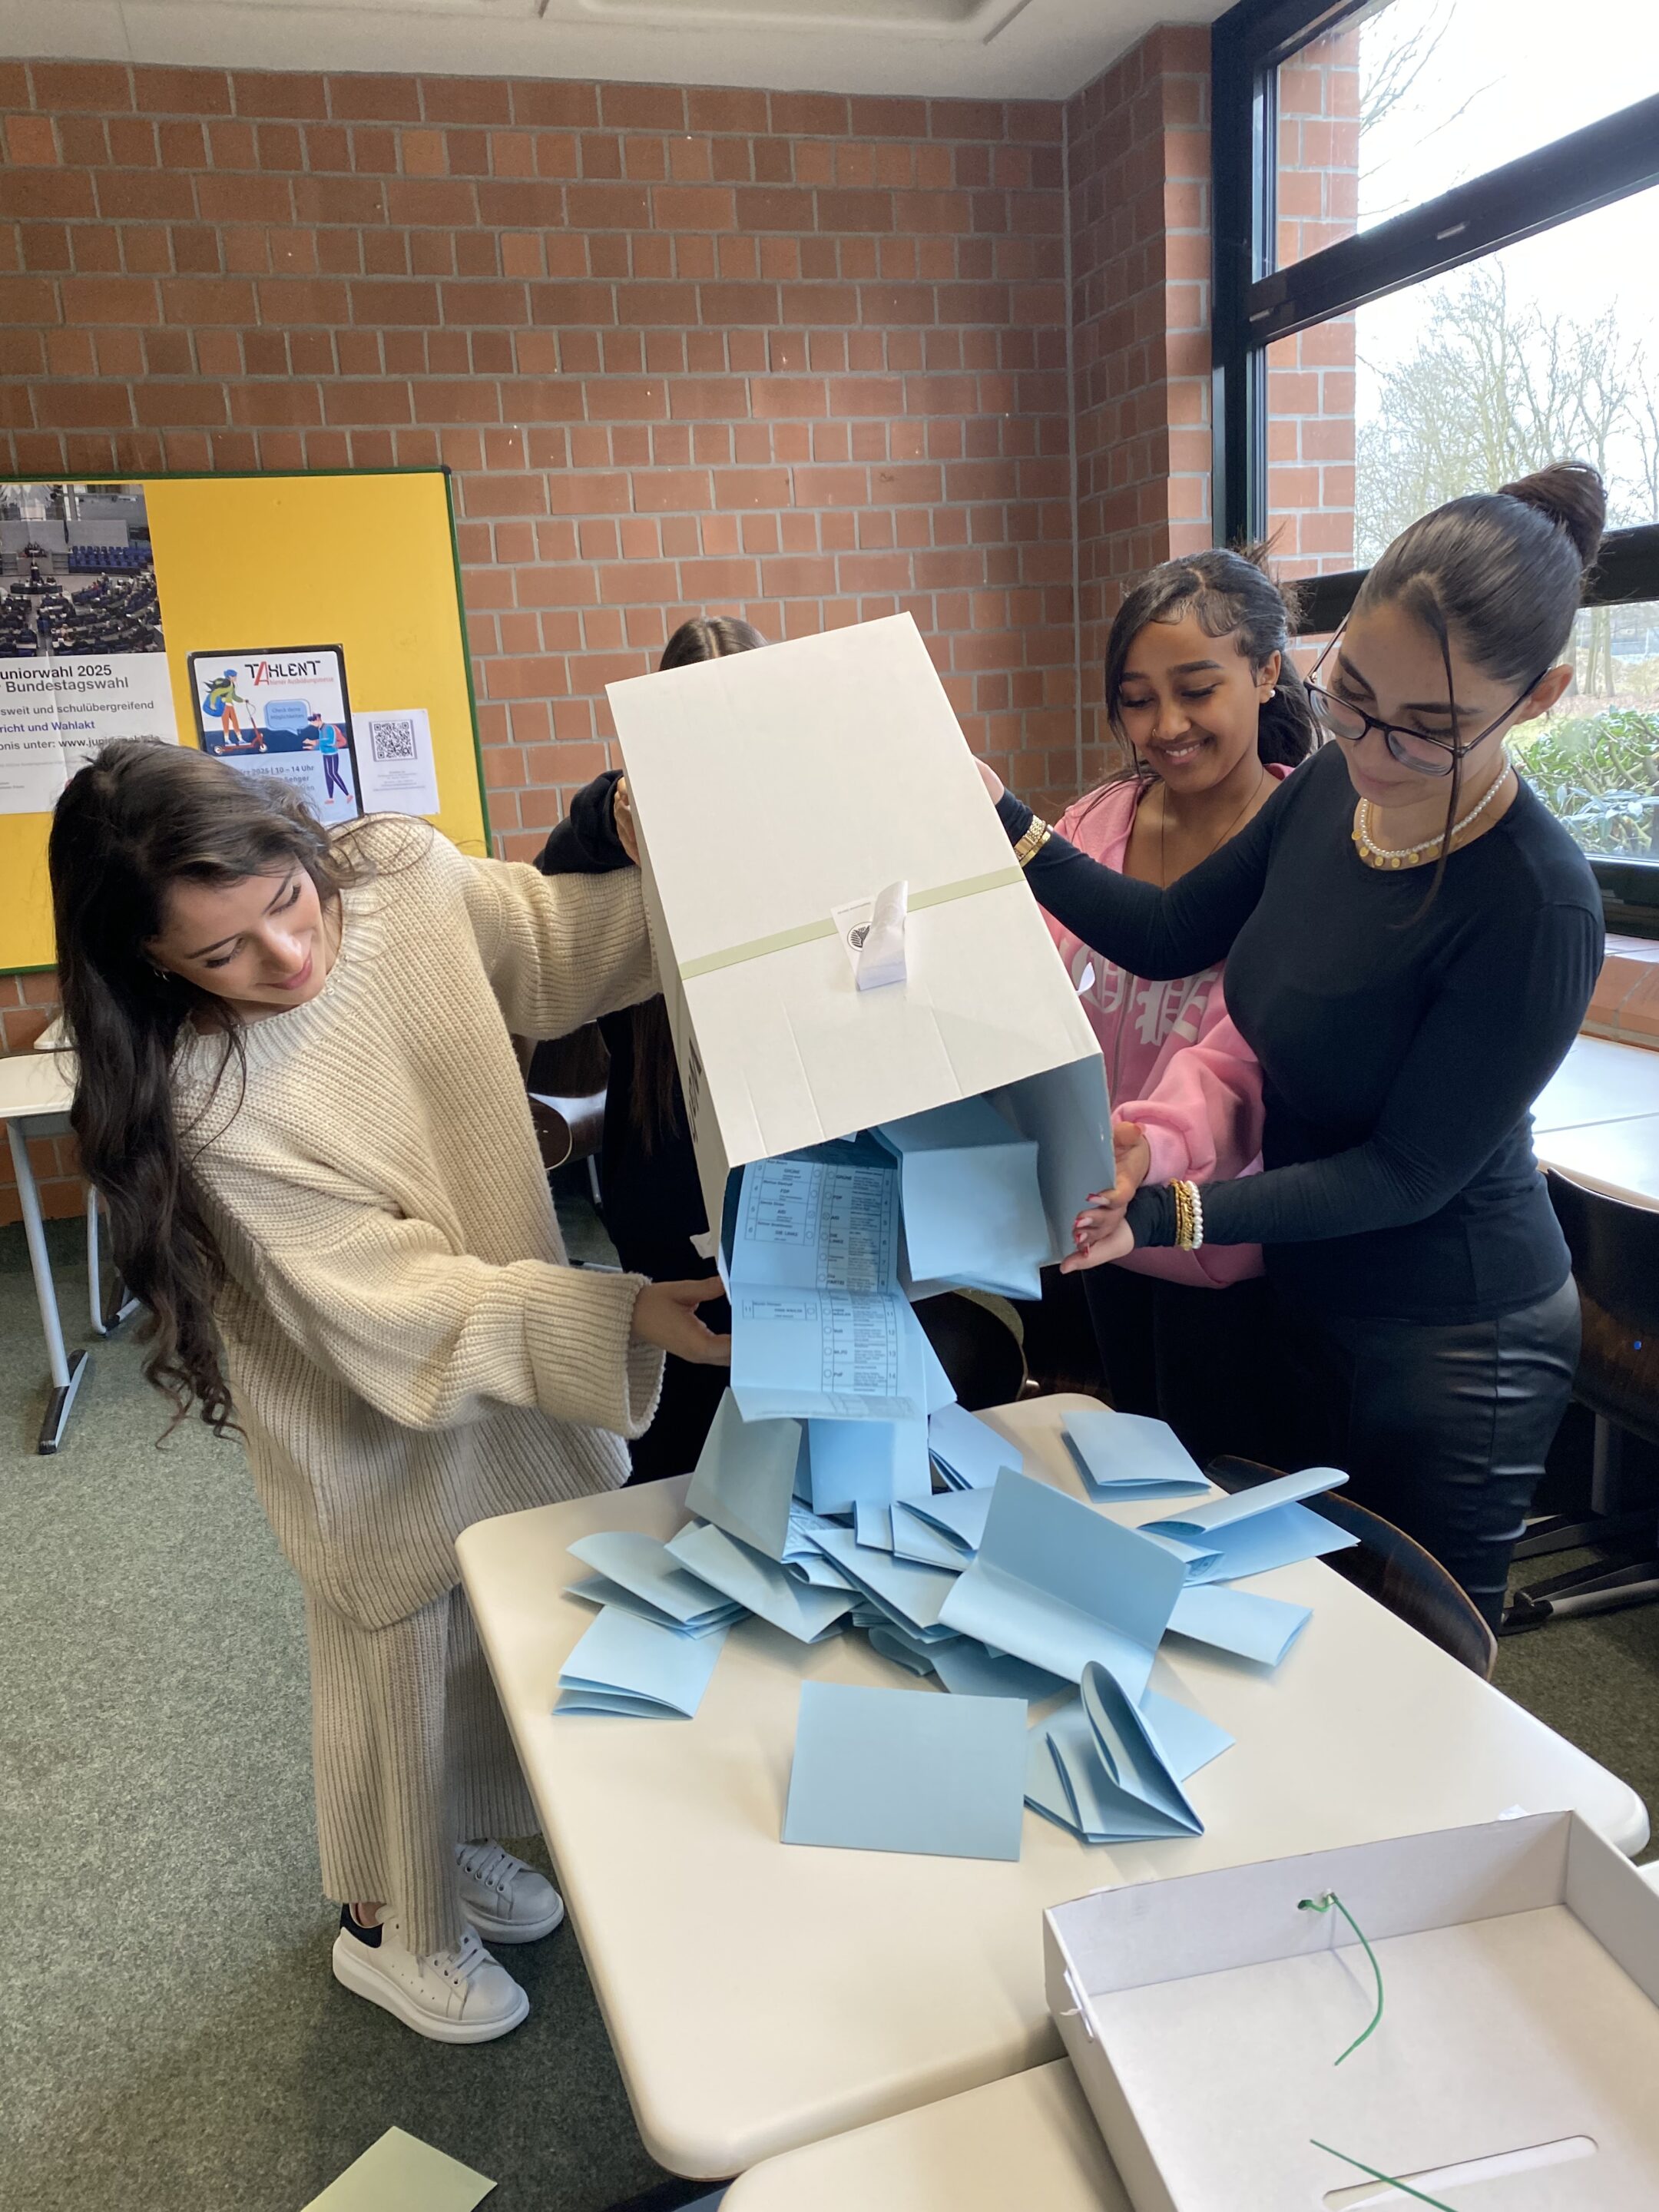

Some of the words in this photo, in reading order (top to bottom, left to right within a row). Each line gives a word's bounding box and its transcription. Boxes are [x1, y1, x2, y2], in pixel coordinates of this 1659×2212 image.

[77, 664, 111, 677] 2025
[6, 677, 129, 692] Bundestagswahl
[33, 705, 54, 714] und
[57, 700, 154, 714] schulübergreifend
[28, 722, 48, 732] und
[51, 720, 96, 730] Wahlakt
[23, 740, 56, 749] unter:
